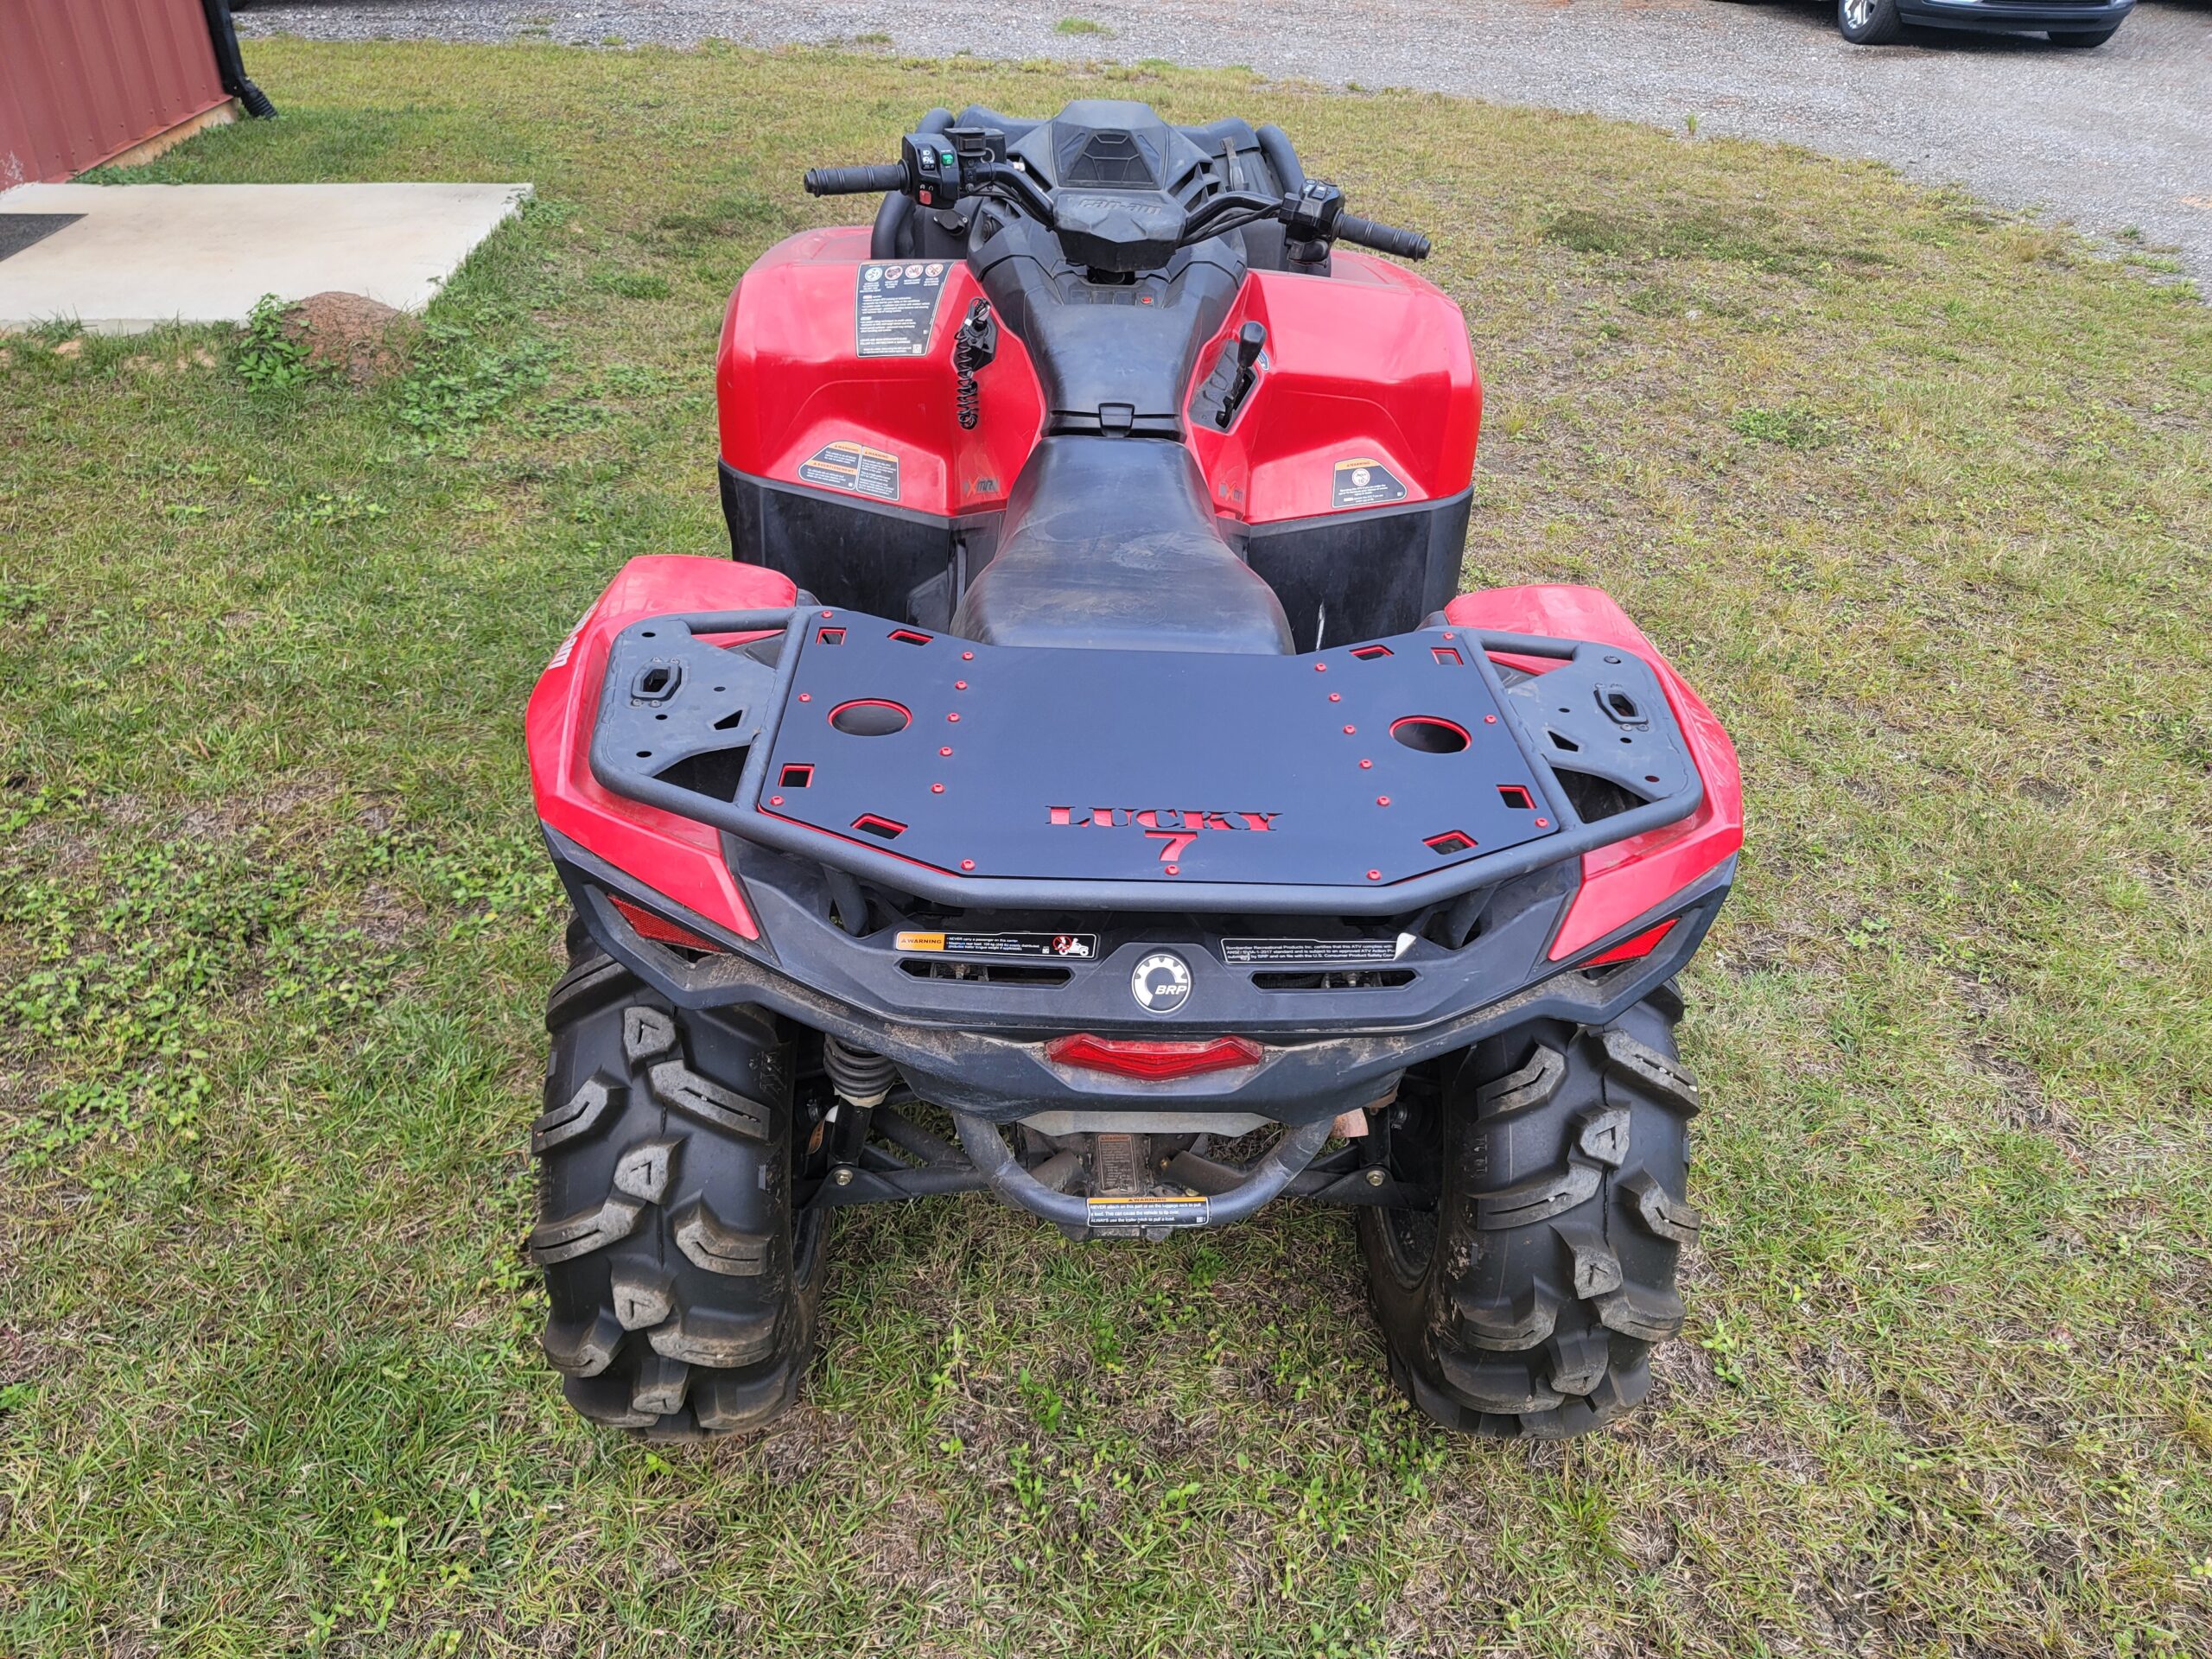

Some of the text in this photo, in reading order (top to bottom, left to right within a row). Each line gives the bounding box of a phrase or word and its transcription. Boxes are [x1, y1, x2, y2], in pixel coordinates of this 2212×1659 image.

[1045, 805, 1283, 831] LUCKY
[1144, 830, 1198, 861] 7
[1155, 985, 1187, 995] BRP
